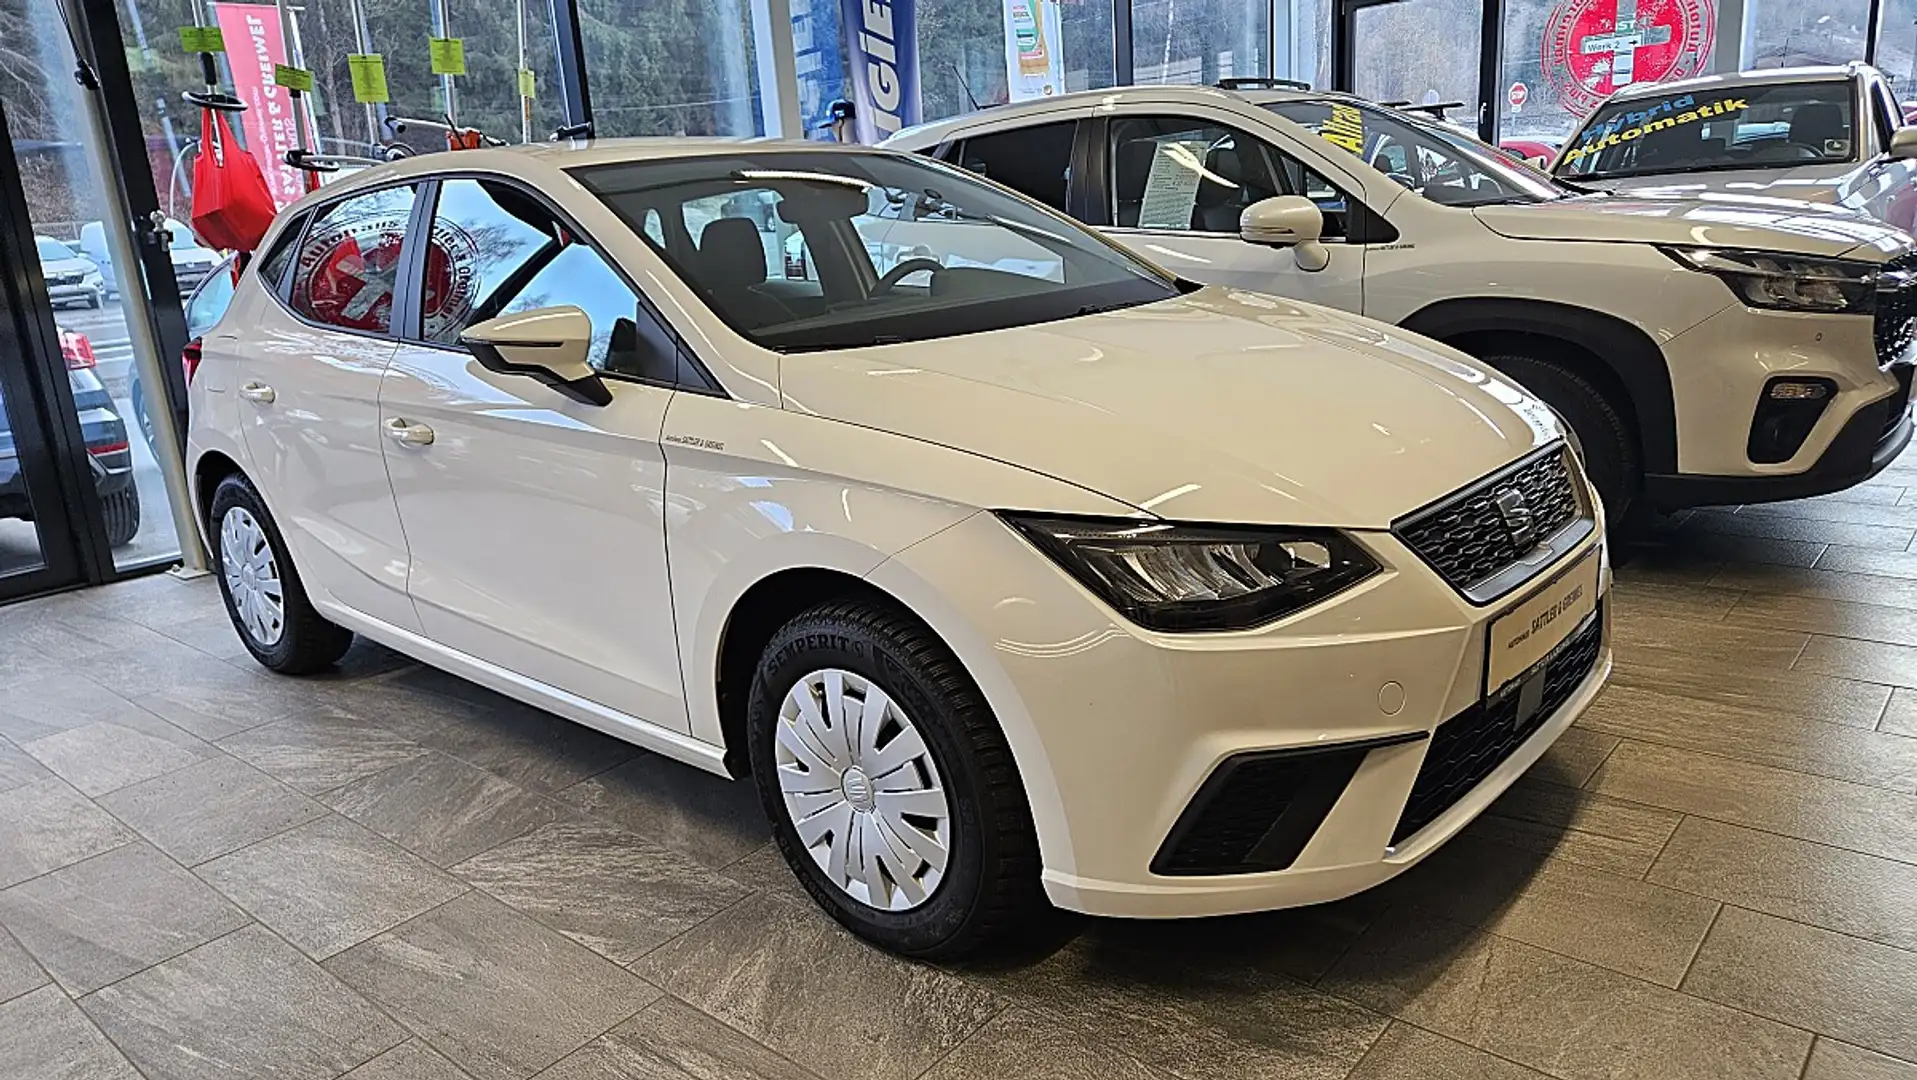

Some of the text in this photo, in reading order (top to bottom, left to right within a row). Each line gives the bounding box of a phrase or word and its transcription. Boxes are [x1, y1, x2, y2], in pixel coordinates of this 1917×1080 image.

[1614, 41, 1621, 49] 2
[1562, 98, 1750, 166] Automatik
[1581, 94, 1695, 142] Hybrid
[1531, 603, 1557, 634] SATTLER
[767, 633, 851, 677] SEMPERIT
